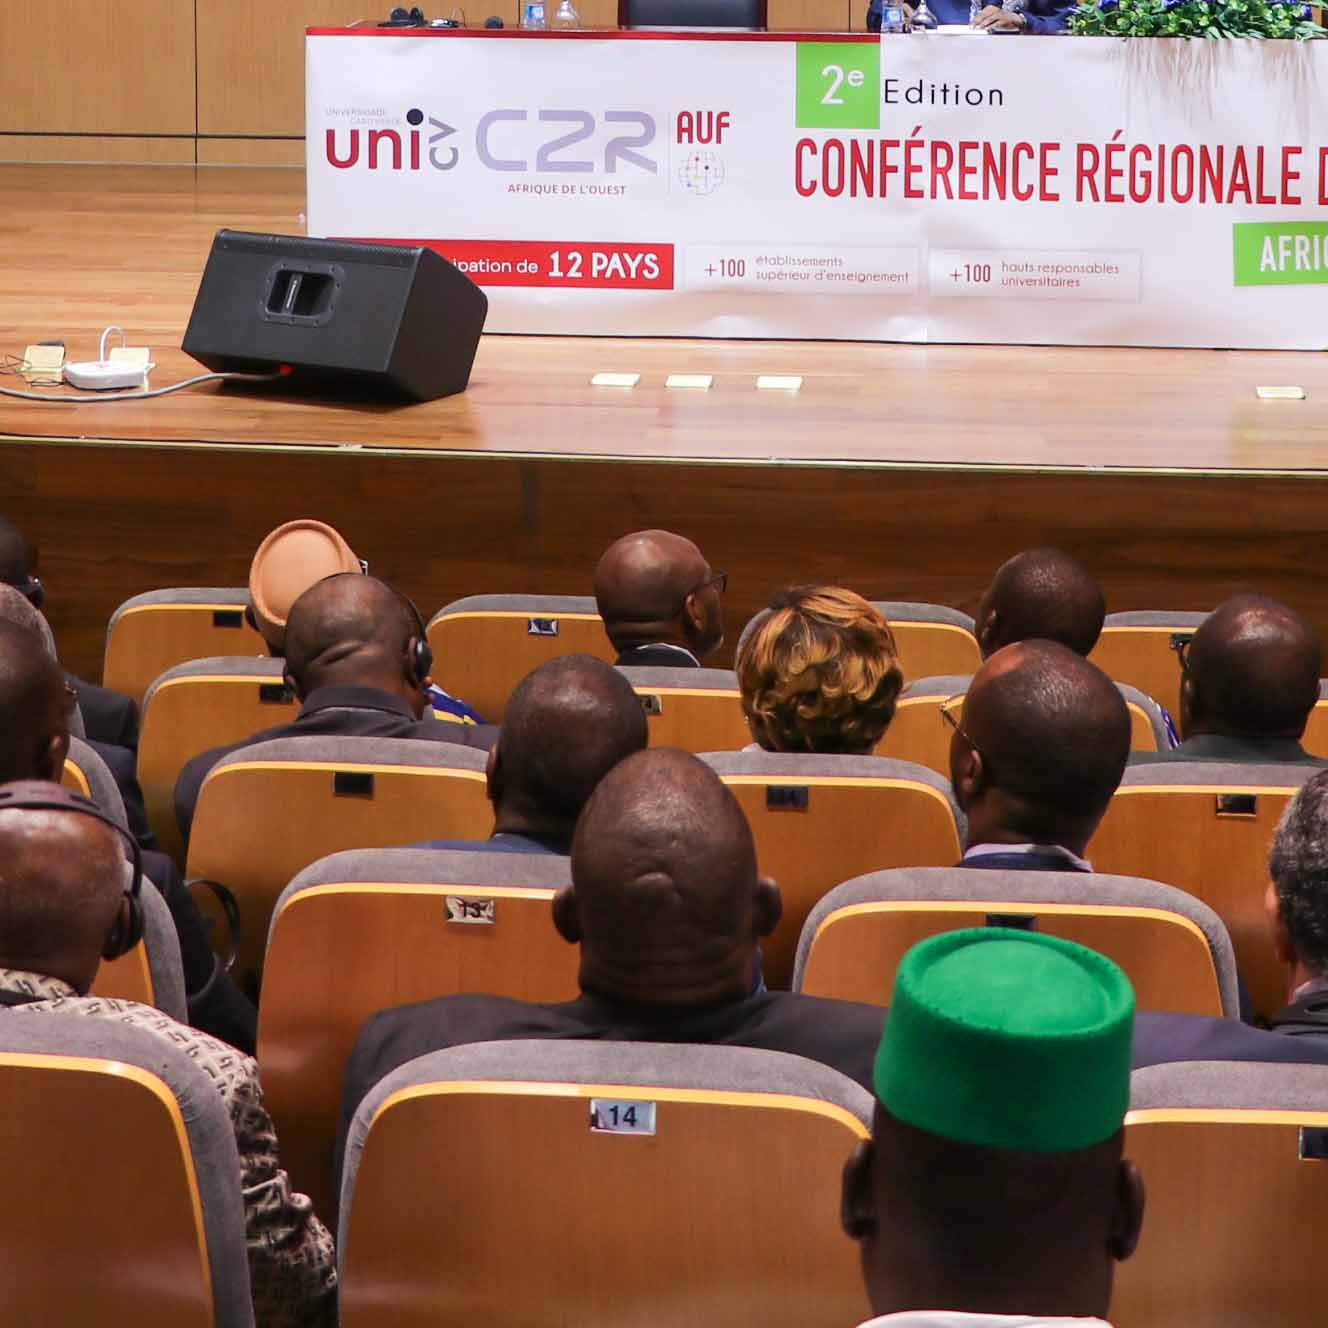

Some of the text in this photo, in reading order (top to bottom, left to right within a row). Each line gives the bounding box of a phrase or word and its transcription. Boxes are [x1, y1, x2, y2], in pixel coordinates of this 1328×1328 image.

[884, 78, 1004, 106] Edition
[677, 110, 730, 145] AUF
[795, 125, 1060, 202] CONFÉRENCE
[1075, 129, 1302, 205] RÉGIONALE
[508, 183, 626, 196] AFRIQUE DE L'OUEST
[516, 258, 539, 274] de
[548, 251, 584, 278] 12
[591, 252, 660, 280] PAYS
[704, 257, 746, 279] +100
[756, 254, 844, 269] établissements
[1001, 260, 1119, 278] hauts responsables
[756, 268, 909, 287] supérieur d'enseignement
[949, 263, 992, 284] +100
[1001, 275, 1080, 289] universitaires
[460, 903, 483, 918] 13
[609, 1105, 637, 1127] 14
